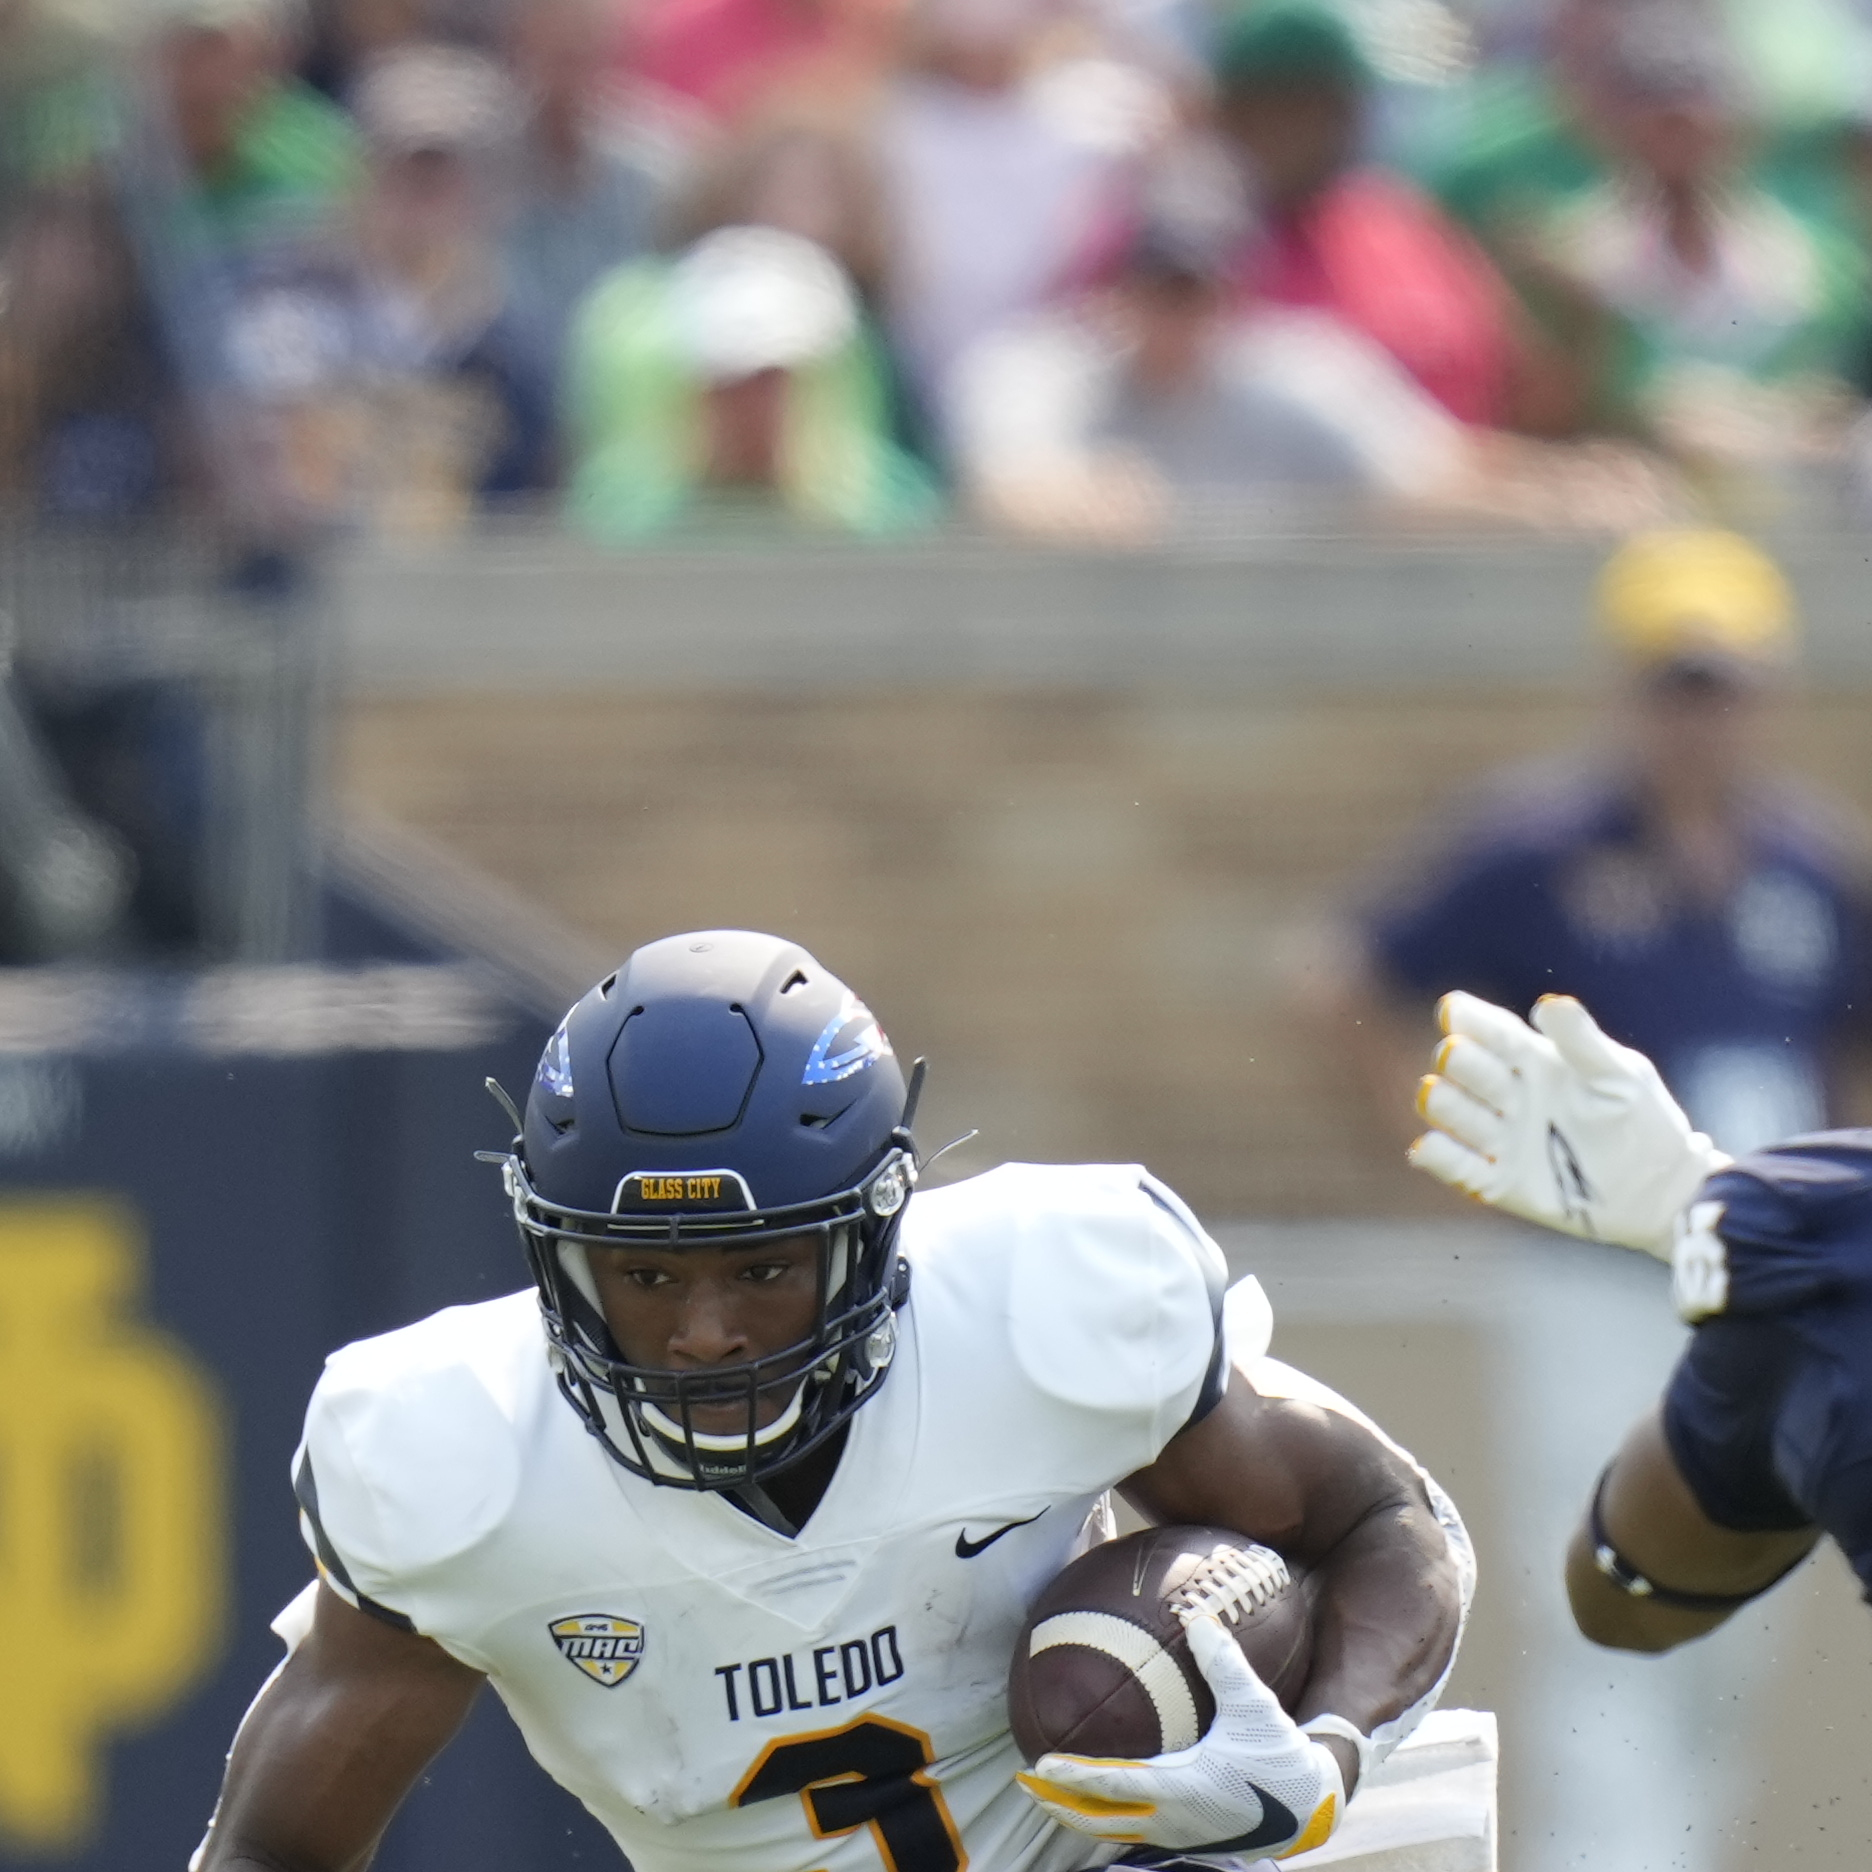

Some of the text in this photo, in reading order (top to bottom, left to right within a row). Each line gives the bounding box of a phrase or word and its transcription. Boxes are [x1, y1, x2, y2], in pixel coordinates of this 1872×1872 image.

[641, 1176, 722, 1200] GLASS CITY
[558, 1638, 643, 1658] MAC
[714, 1624, 904, 1721] TOLEDO
